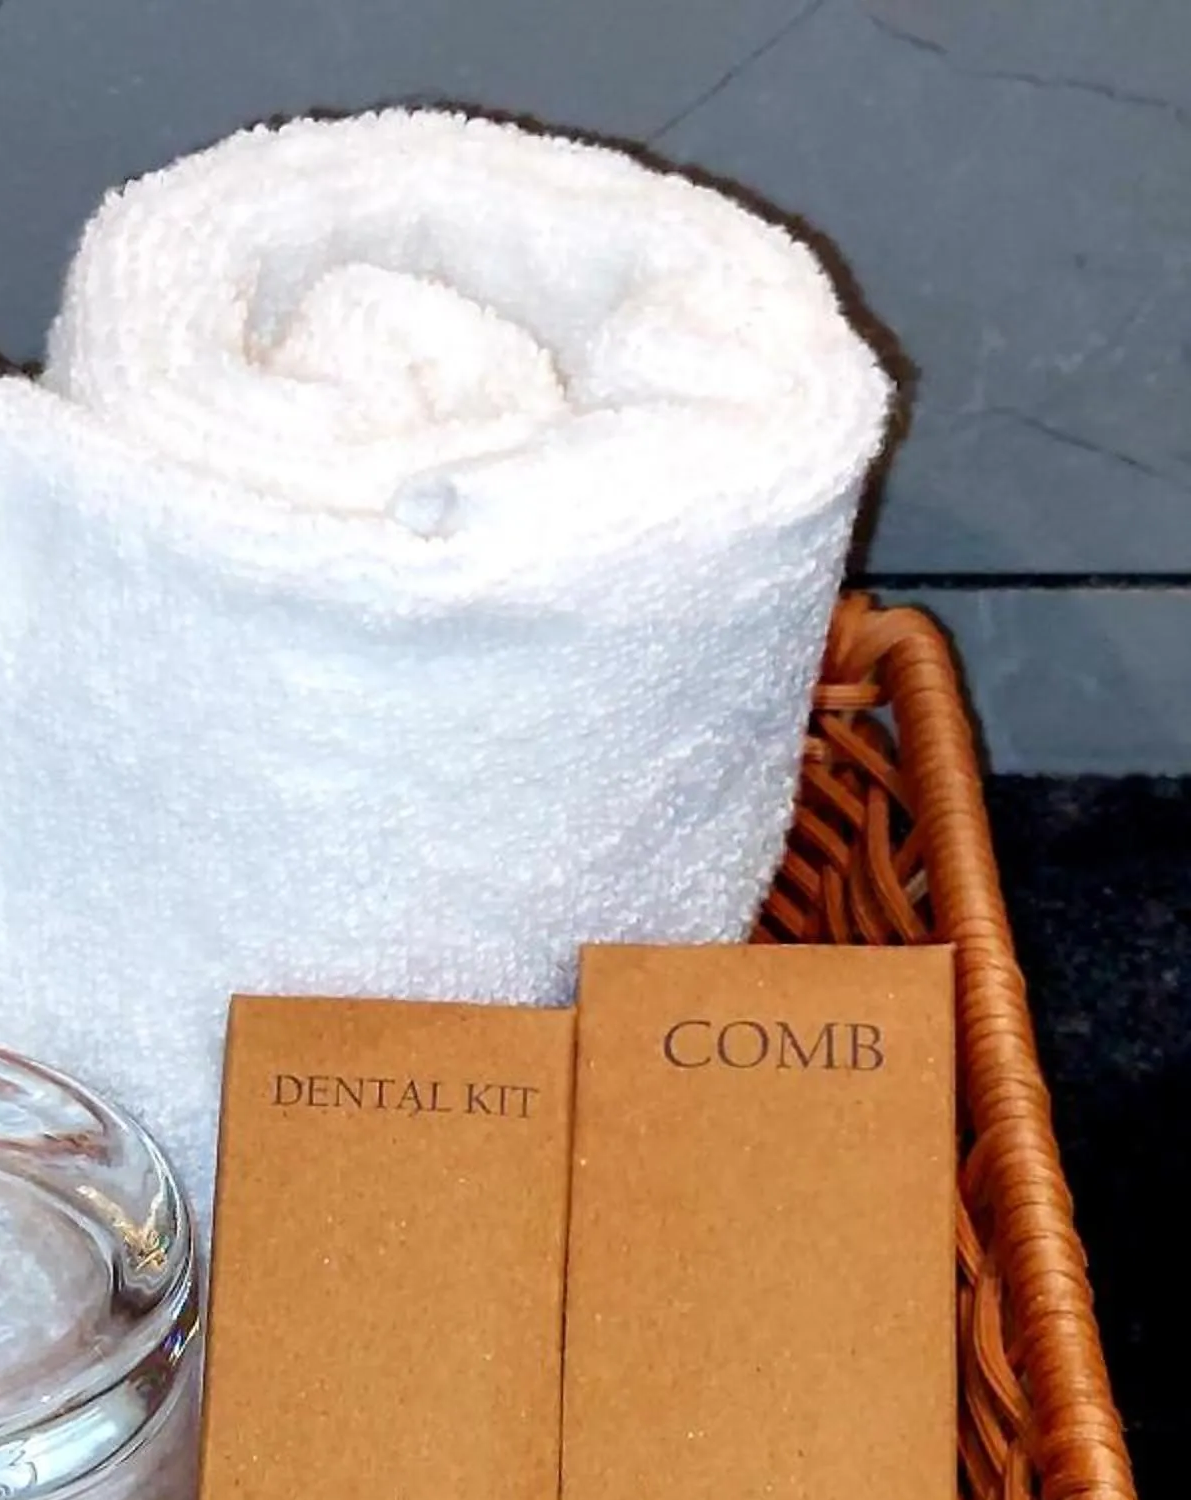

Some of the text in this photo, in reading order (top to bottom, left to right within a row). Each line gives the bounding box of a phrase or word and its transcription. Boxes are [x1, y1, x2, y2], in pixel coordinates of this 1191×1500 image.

[662, 1019, 886, 1072] COMB
[273, 1073, 541, 1120] DENTAL KIT
